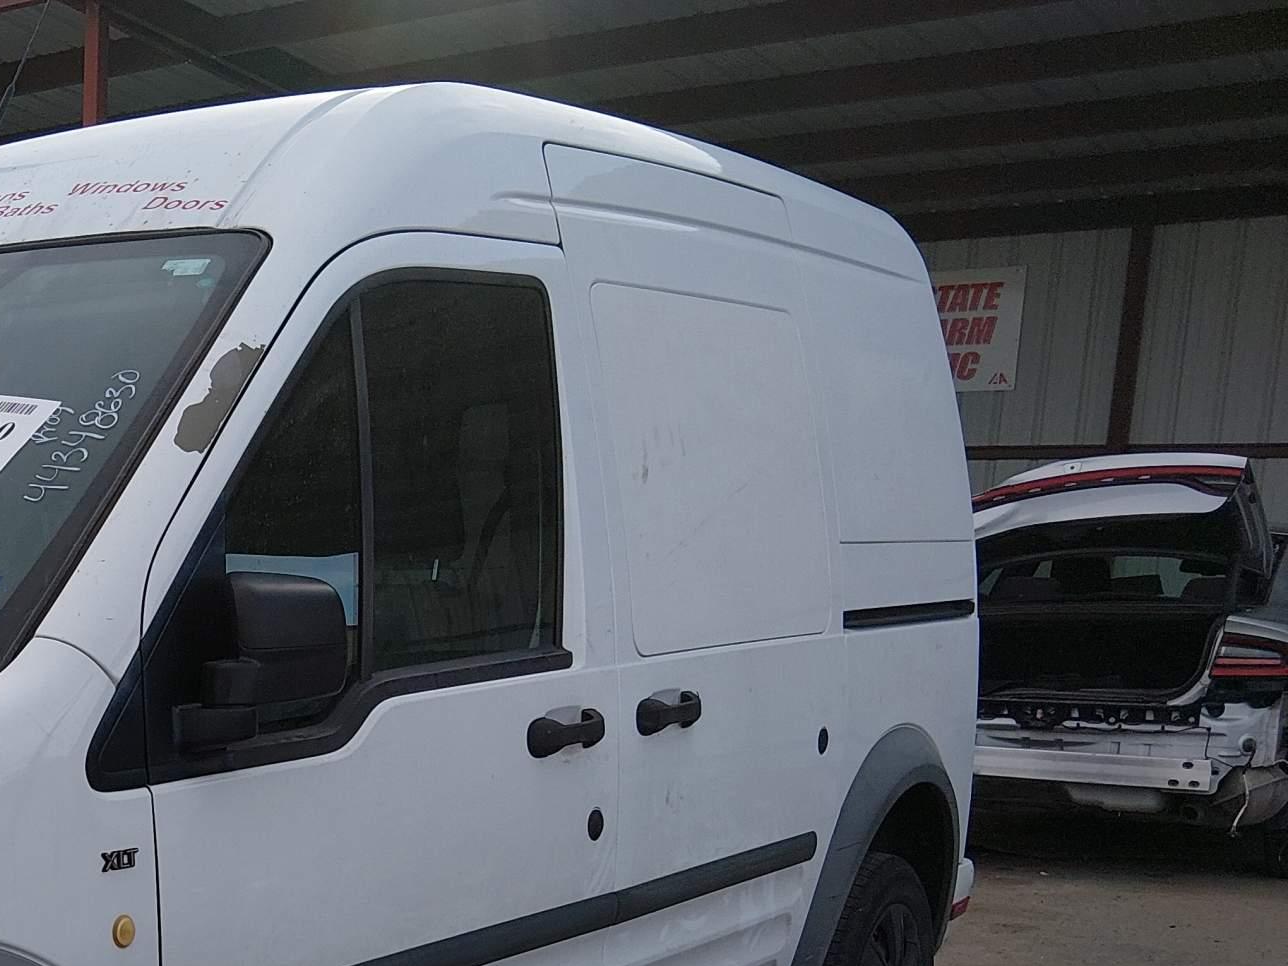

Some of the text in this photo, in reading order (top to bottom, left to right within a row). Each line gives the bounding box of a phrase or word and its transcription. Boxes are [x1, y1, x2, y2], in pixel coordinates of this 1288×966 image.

[68, 180, 189, 196] Windows
[142, 196, 229, 211] Doors
[934, 282, 1004, 313] TATE
[23, 369, 140, 502] 44348630
[100, 847, 140, 873] XLT
